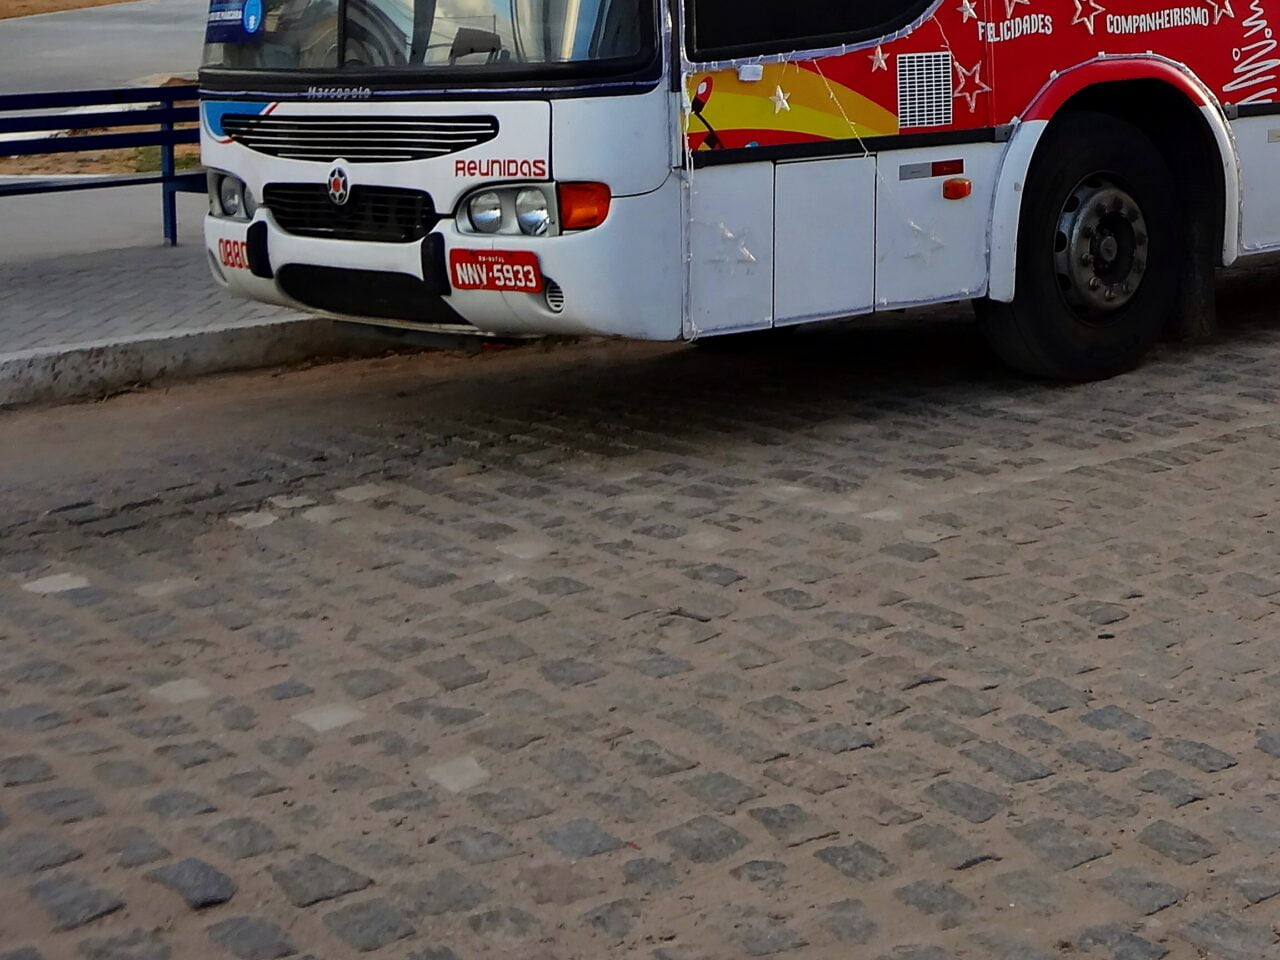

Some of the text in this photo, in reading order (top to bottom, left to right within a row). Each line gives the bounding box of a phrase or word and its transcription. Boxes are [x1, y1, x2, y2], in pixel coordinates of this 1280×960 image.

[977, 13, 1053, 42] FELICIDADES
[1106, 7, 1209, 34] COMPANHEIRISMO
[307, 86, 371, 100] Marcopolo
